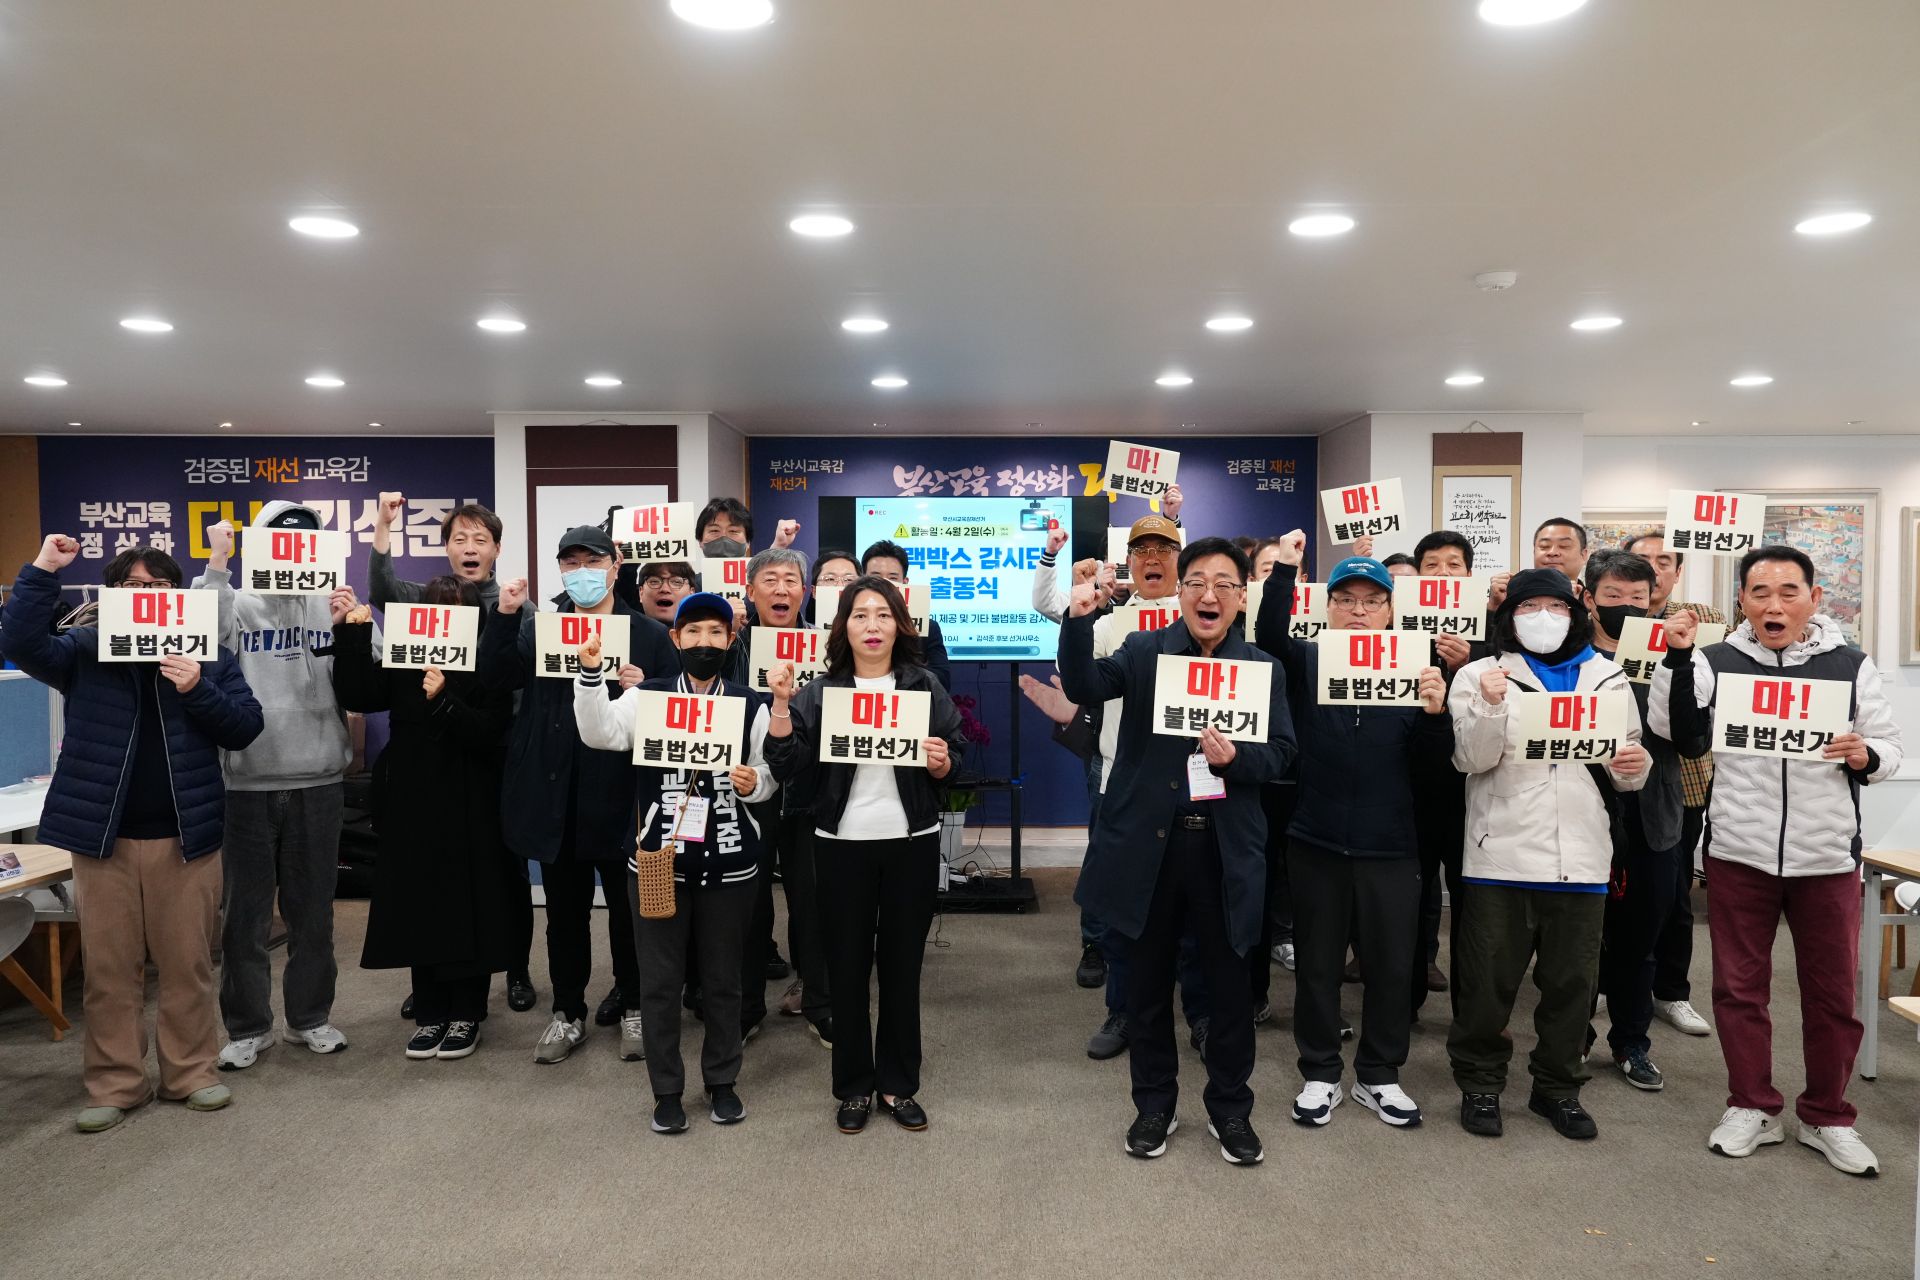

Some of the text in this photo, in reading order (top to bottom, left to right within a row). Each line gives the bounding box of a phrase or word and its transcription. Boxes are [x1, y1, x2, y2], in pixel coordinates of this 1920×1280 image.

[184, 456, 371, 483] 검증된 재선 교육감
[770, 459, 844, 473] 부산시교육감
[1127, 447, 1159, 474] 마!
[1227, 459, 1296, 475] 검증된 재선
[770, 476, 807, 490] 재선거
[893, 464, 992, 496] 부산교육
[996, 463, 1075, 496] 정상화
[1111, 474, 1168, 495] 불법선거
[1256, 478, 1296, 492] 교육감
[1342, 486, 1379, 514] 마!
[1694, 495, 1738, 525] 마!
[79, 502, 171, 528] 부산교육
[633, 507, 669, 534] 마!
[1335, 515, 1399, 540] 불법선거
[945, 527, 961, 536] 4월
[964, 527, 995, 536] 2일(수)
[1673, 530, 1754, 551] 불법선거
[272, 532, 316, 563] 마!
[619, 540, 688, 559] 불법선거
[904, 547, 972, 570] 랙박스
[252, 570, 337, 590] 불법선거
[930, 577, 998, 600] 출동식
[1420, 580, 1461, 609] 마!
[133, 593, 184, 627] 마!
[409, 608, 450, 638] 마!
[939, 613, 957, 624] 제공
[959, 613, 969, 624] 및
[971, 613, 989, 624] 기타
[991, 613, 1027, 624] 불법활동
[1401, 616, 1478, 636] 불법선거
[110, 635, 207, 656] 불법선거
[391, 644, 467, 666] 불법선거
[776, 632, 817, 663] 마!
[1350, 634, 1397, 670] 마!
[544, 653, 620, 673] 불법거
[1187, 661, 1238, 700] 마!
[1328, 678, 1420, 700] 불법선거
[852, 692, 899, 728] 마!
[1752, 680, 1811, 720] 마!
[666, 697, 714, 733] 마!
[1164, 705, 1258, 736] 불법선거
[1550, 696, 1597, 731] 마!
[830, 735, 918, 760] 불법선거
[1526, 739, 1616, 759] 불법선거
[1725, 723, 1834, 753] 불법선거
[643, 738, 732, 766] 불법선거
